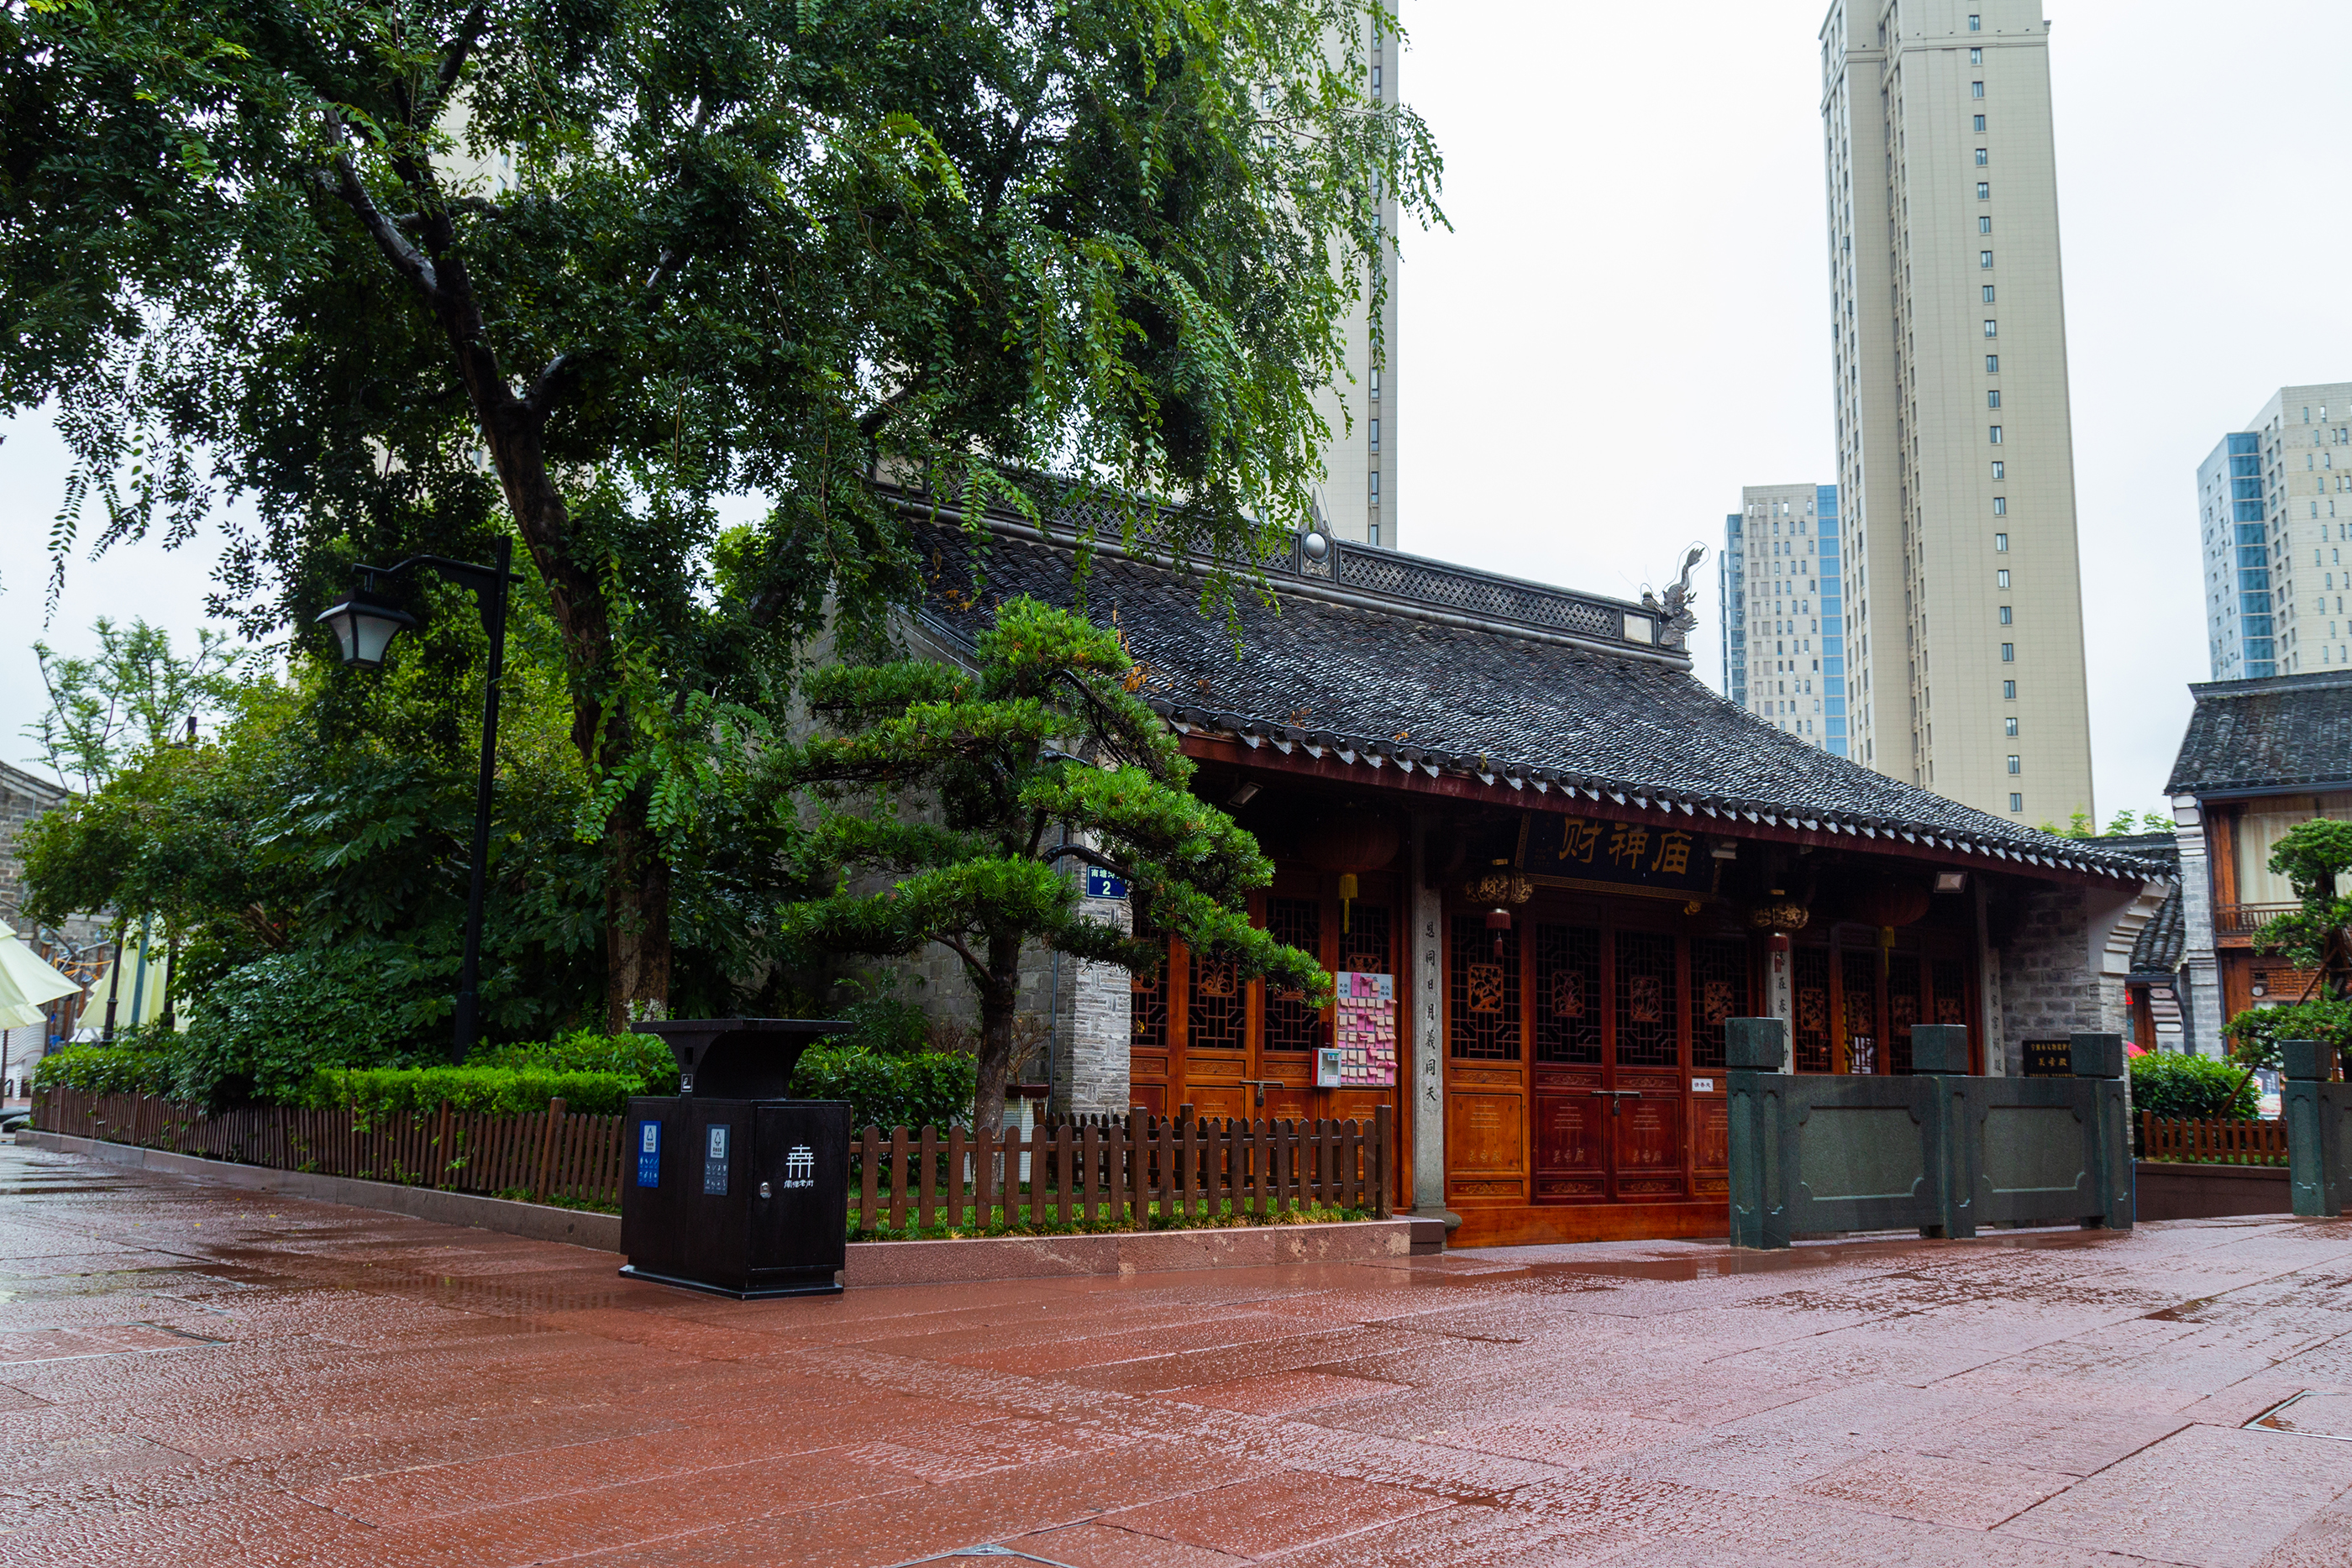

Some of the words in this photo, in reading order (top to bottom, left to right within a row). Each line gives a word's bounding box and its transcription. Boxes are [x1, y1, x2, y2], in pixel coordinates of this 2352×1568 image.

[1558, 816, 1693, 875] 财神庙
[1090, 868, 1121, 878] 南塘河
[1102, 880, 1111, 895] 2
